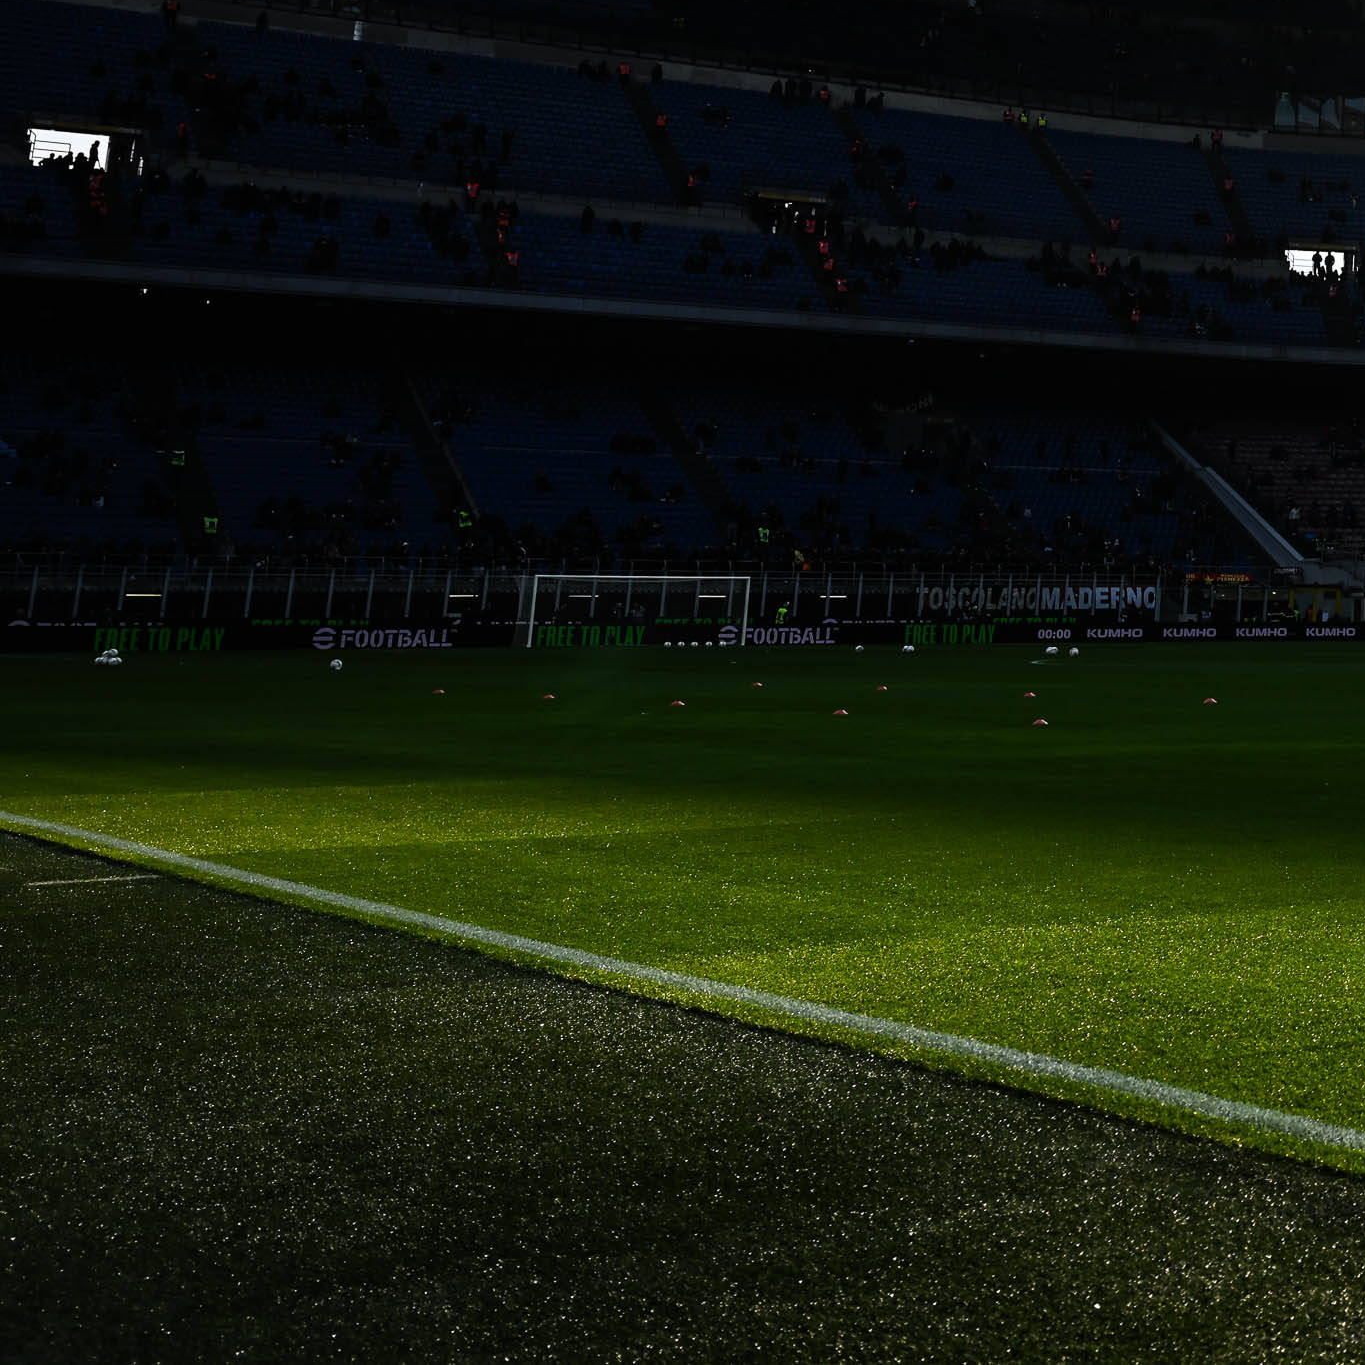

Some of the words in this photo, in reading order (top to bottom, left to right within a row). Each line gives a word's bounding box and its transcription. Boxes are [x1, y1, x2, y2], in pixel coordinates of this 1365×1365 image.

[535, 625, 577, 649] FREE
[579, 625, 600, 648] TO
[604, 625, 648, 648] PLAY
[904, 623, 937, 644] FREE
[941, 623, 960, 644] TO
[961, 623, 997, 644] PLAY
[1036, 628, 1072, 640] 00:00
[1086, 627, 1144, 638] KUMHO
[1162, 627, 1217, 638] KUMHO
[1235, 627, 1288, 637] KUMHO
[1305, 627, 1357, 637] KUMHO
[92, 626, 144, 651] FREE
[148, 626, 172, 651] TO
[175, 626, 226, 651] PLAY
